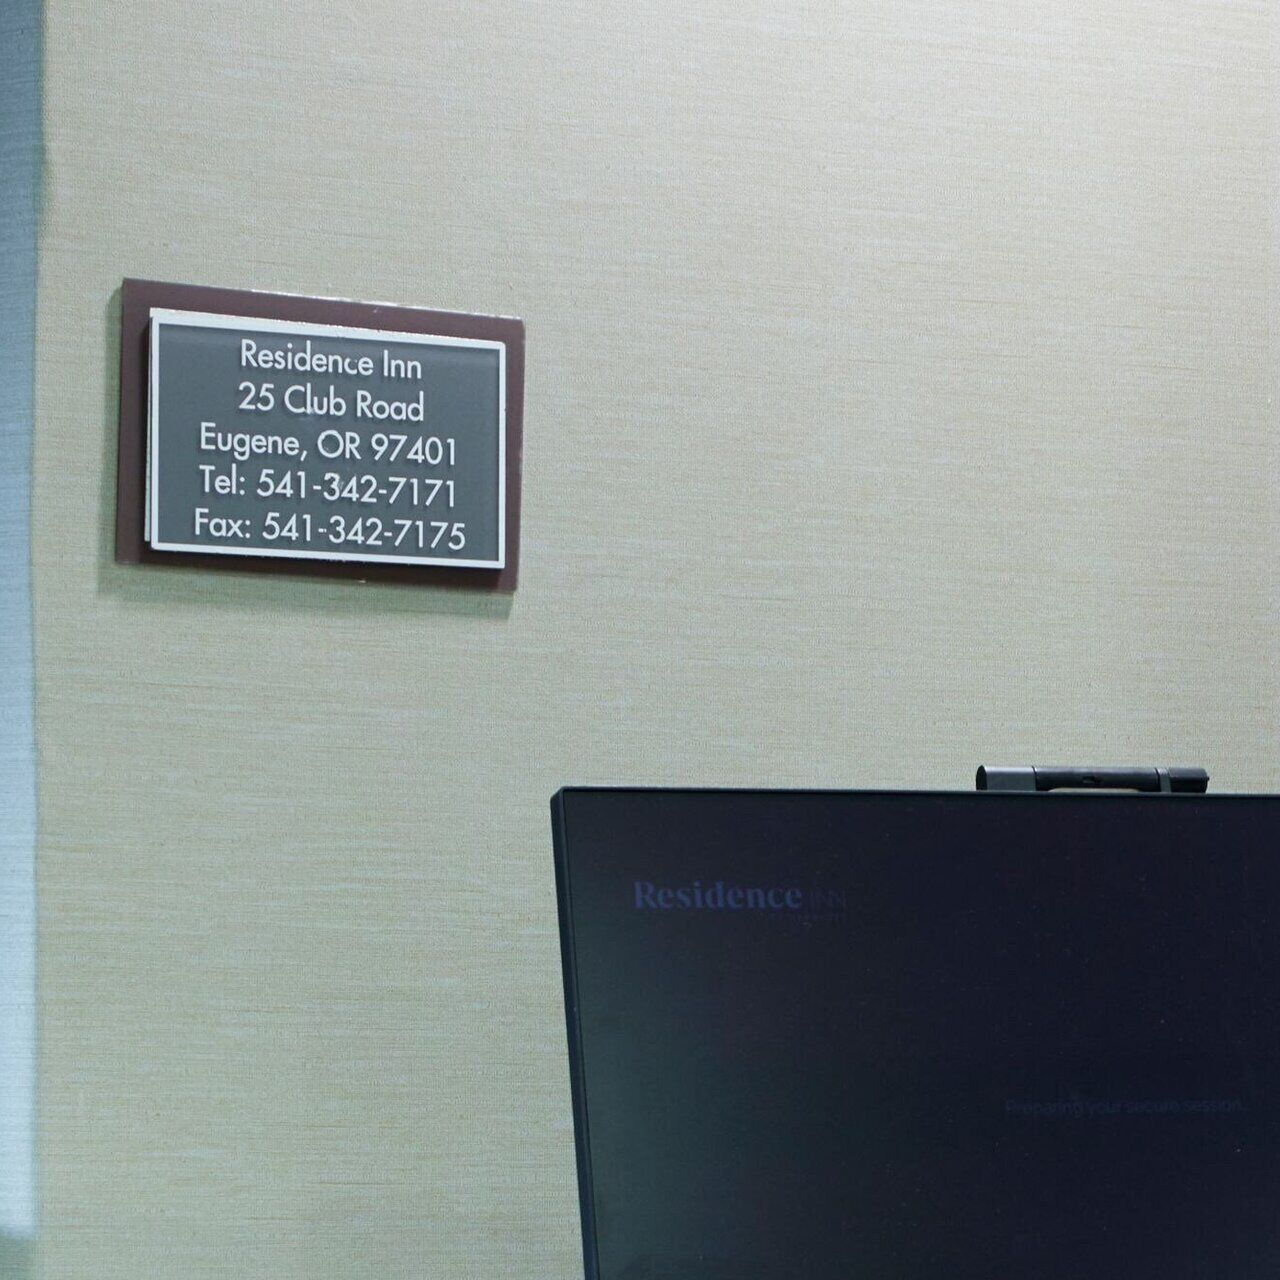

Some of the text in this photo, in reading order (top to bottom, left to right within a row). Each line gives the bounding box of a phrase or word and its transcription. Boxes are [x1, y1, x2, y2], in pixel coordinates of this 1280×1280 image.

[241, 338, 422, 380] Residence Inn
[238, 380, 425, 422] 25 Club Road
[200, 421, 455, 466] Eugene, OR 97401
[198, 463, 455, 508] Tel: 541-342-7171
[195, 507, 466, 551] Fax: 541-342-7175
[633, 879, 803, 910] Residence
